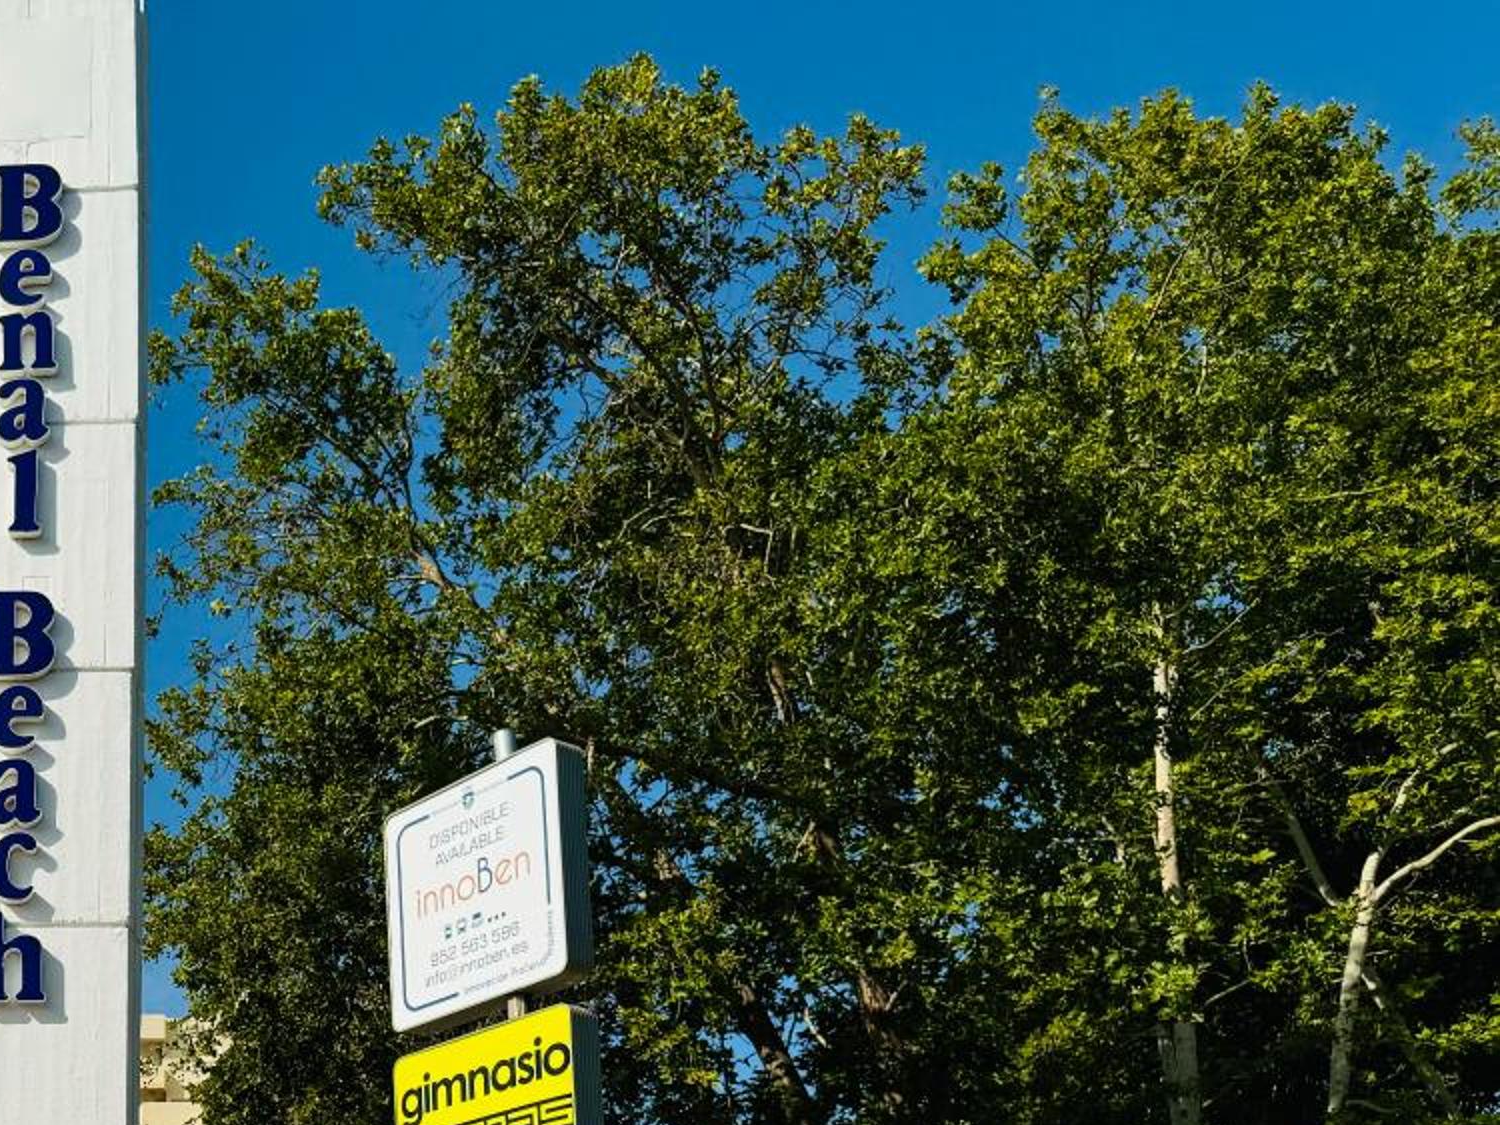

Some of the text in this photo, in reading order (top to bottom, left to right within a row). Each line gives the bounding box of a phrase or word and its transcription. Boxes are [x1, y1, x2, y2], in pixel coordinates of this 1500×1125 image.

[428, 801, 510, 850] DISPONIBLE
[435, 825, 505, 867] AVAILABLE
[415, 850, 531, 920] innoBen
